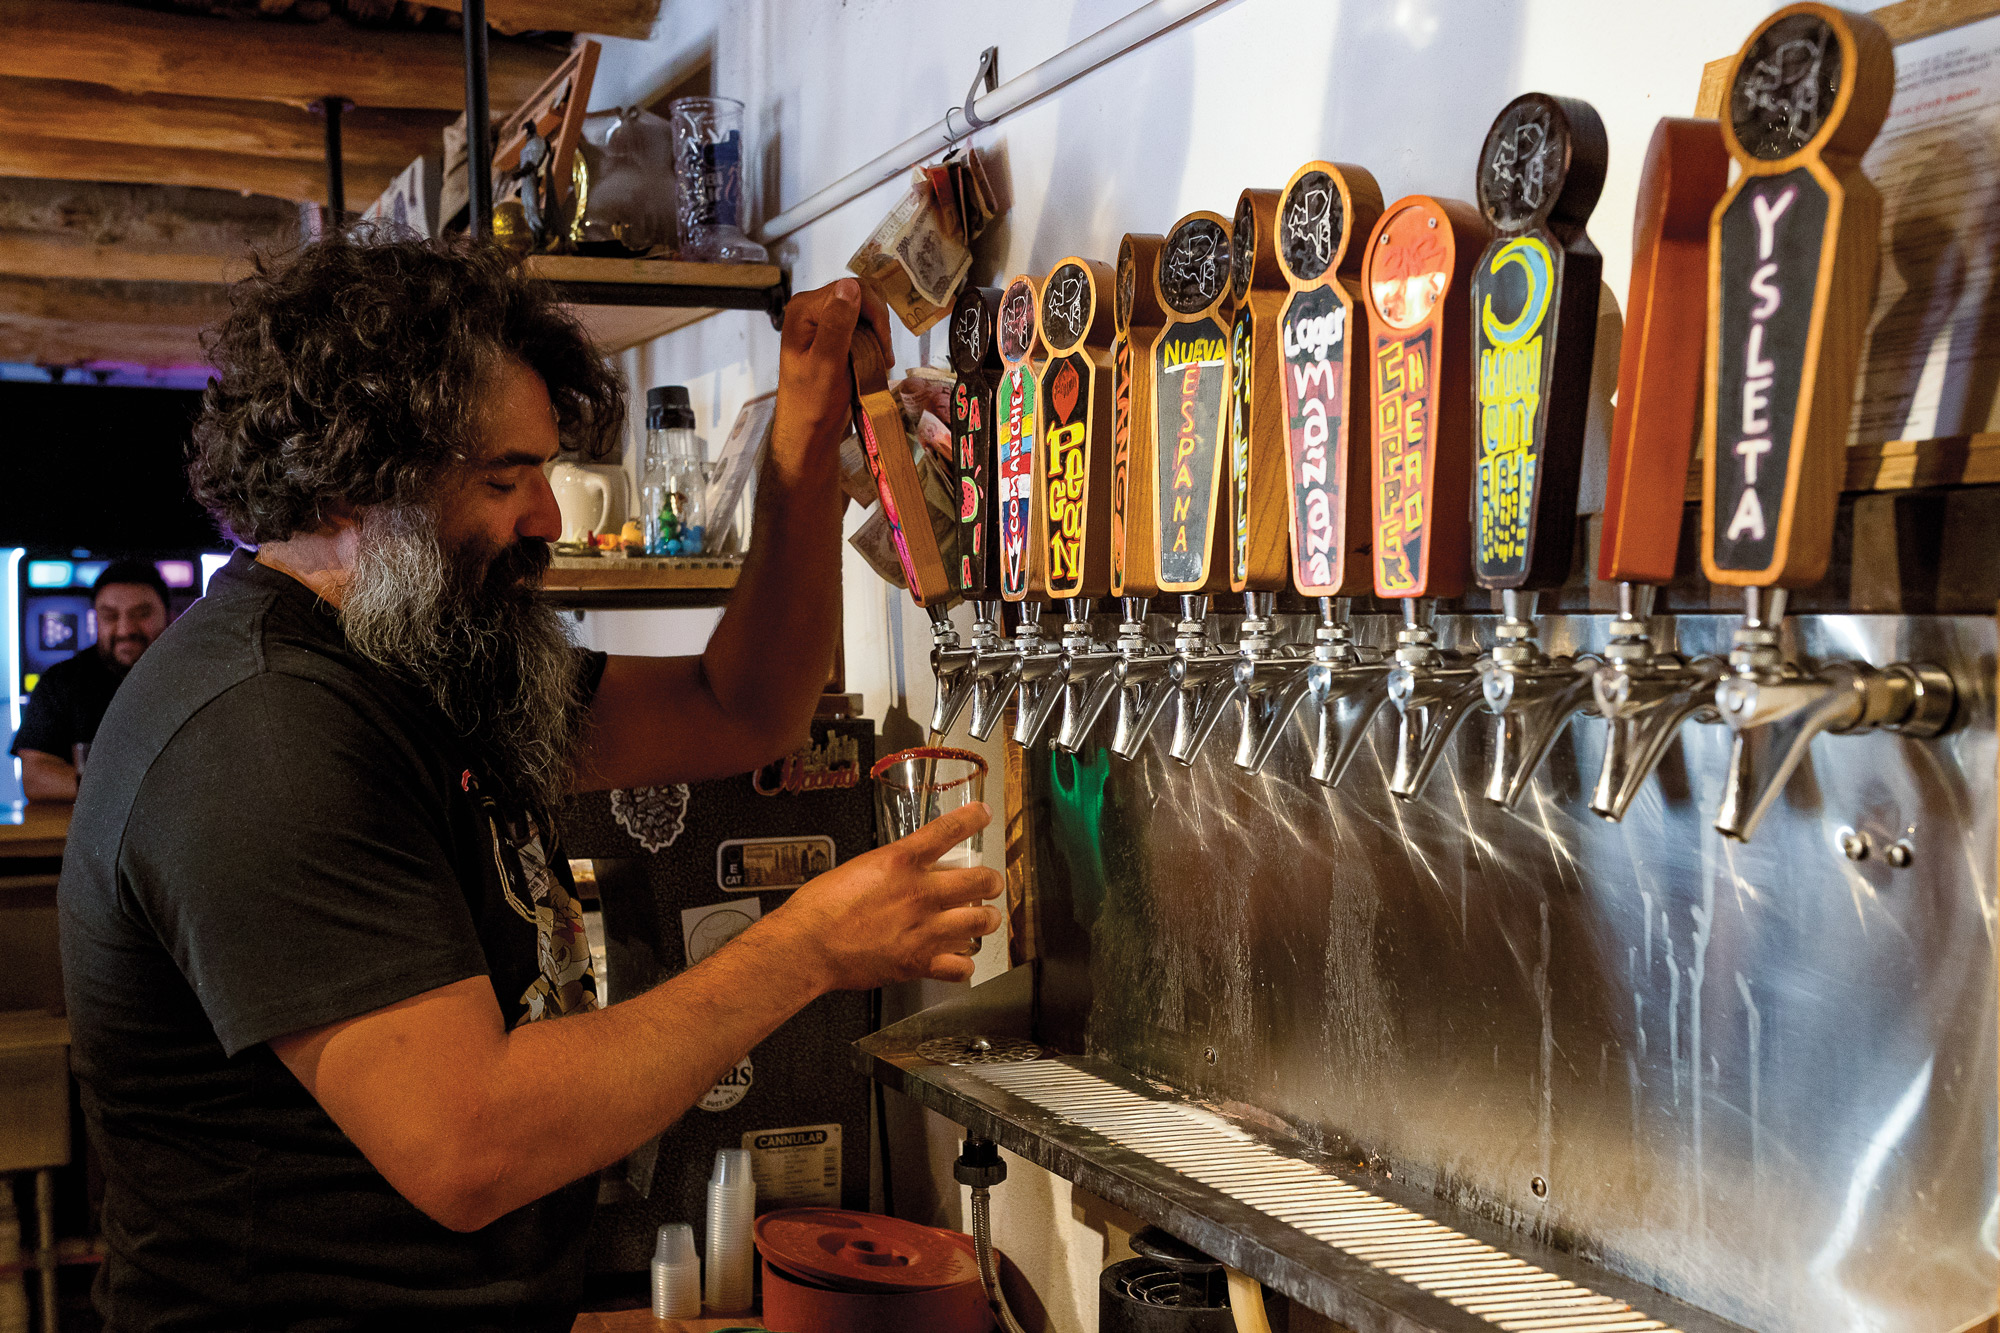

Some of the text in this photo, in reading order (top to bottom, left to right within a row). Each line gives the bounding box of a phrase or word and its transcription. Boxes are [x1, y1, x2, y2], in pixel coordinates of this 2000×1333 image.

[1164, 338, 1226, 367] NUEVA
[1480, 335, 1542, 403] MOON
[1727, 190, 1794, 540] YSLETA
[1405, 352, 1424, 532] HEAD
[1482, 397, 1539, 456] CITY
[1009, 391, 1023, 533] COMANCHE
[725, 875, 742, 885] CAT
[729, 863, 738, 874] E
[758, 1132, 825, 1148] CANNULAR
